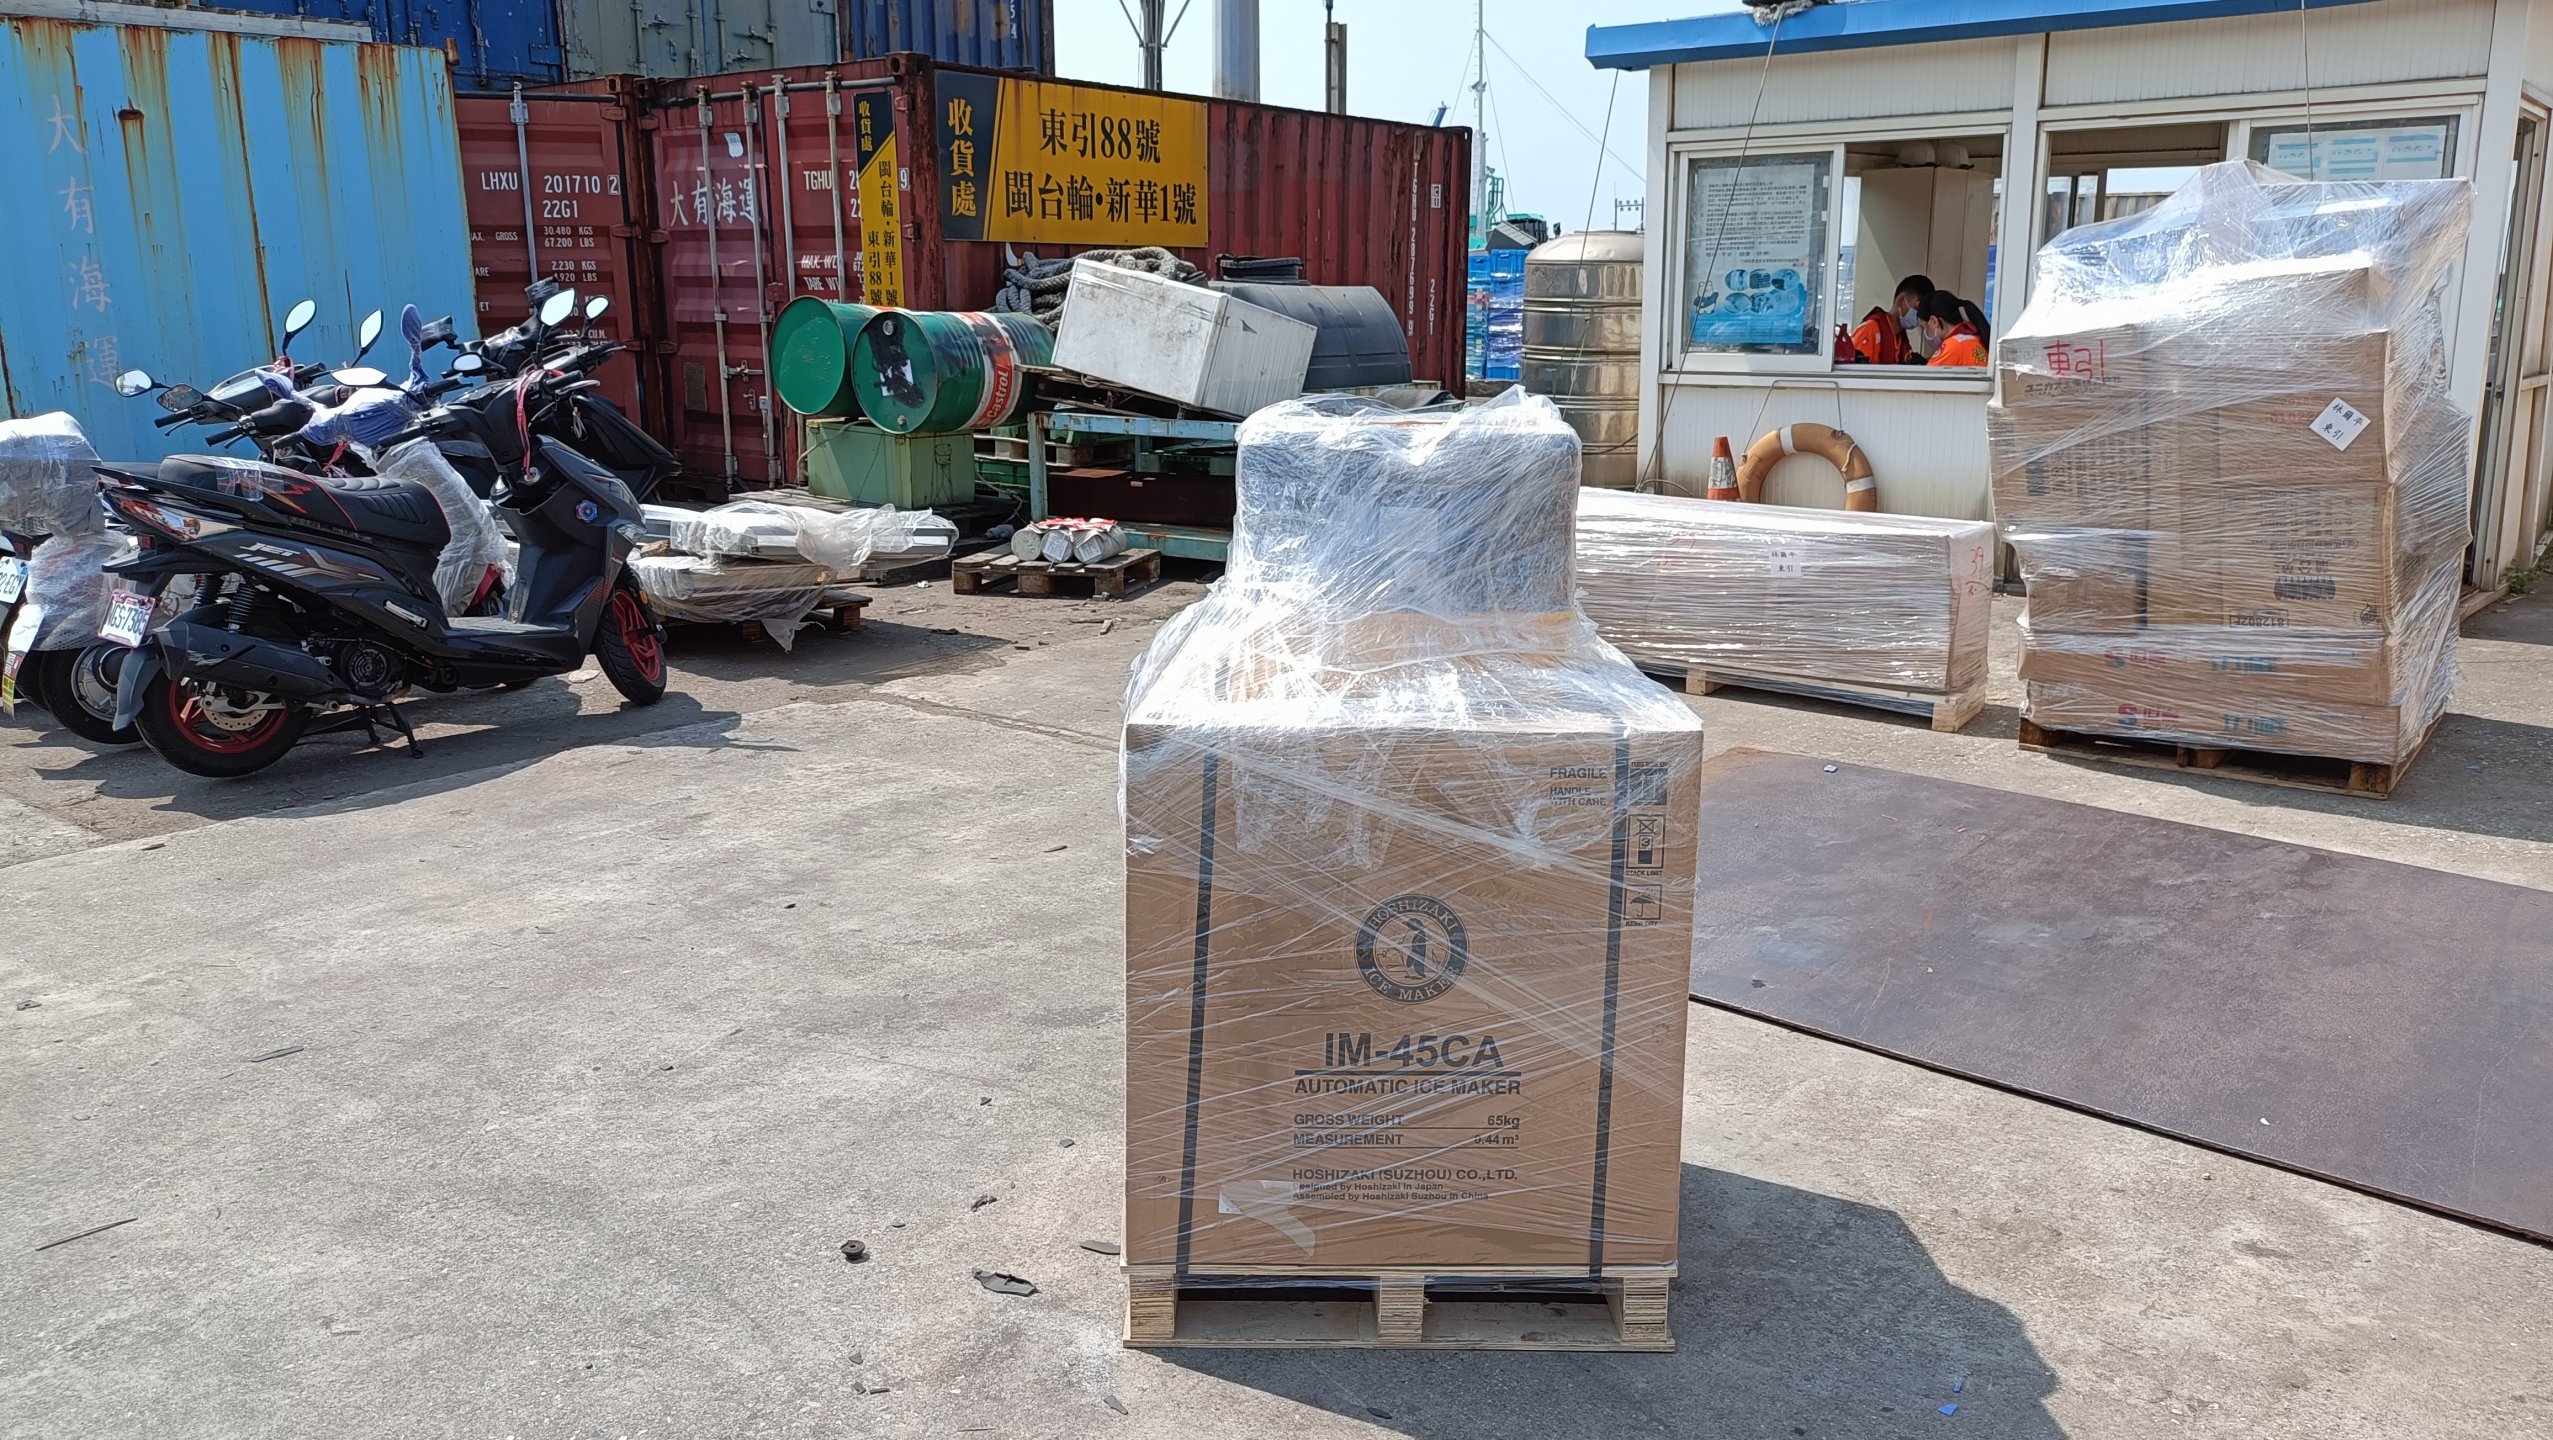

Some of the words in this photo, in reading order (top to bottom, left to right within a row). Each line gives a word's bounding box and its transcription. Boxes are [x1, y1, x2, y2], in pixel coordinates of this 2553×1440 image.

[859, 100, 873, 152] 收貨處
[1039, 108, 1161, 164] 東引88號
[948, 98, 977, 217] 收貨處
[481, 172, 518, 190] LHXU
[544, 175, 601, 194] 201710
[610, 175, 619, 194] 2
[803, 170, 832, 190] TGHU
[900, 169, 908, 188] 9
[542, 200, 579, 218] 22G1
[495, 232, 518, 241] GROSS
[543, 226, 572, 235] 30.480
[578, 227, 594, 235] KGS
[544, 238, 573, 247] 67.200
[579, 238, 595, 247] LBS
[475, 267, 490, 277] ARE
[551, 261, 575, 270] 2.230
[581, 261, 597, 270] KGS
[868, 230, 883, 305] 東引88號
[582, 273, 597, 281] LBS
[987, 370, 1009, 418] Castrol
[239, 542, 300, 557] JET
[1550, 767, 1607, 779] FRAGILE
[1550, 787, 1591, 796] HANDLE
[1578, 797, 1607, 806] CARE
[1641, 837, 1650, 847] 3
[1367, 900, 1458, 930] HOSHIZAKI
[1364, 967, 1393, 994] ICE
[1398, 965, 1460, 1000] MAKER
[1325, 1033, 1504, 1067] IM-45CA
[1294, 1079, 1408, 1094] AUTOMATIC
[1414, 1080, 1445, 1094] ICE
[1451, 1080, 1521, 1095] MAKER
[1294, 1114, 1344, 1125] GROSS
[1347, 1114, 1405, 1126] WEIGHT
[1487, 1115, 1520, 1129] 65kg
[1294, 1134, 1404, 1145] MEASUREMENT
[1292, 1169, 1375, 1180] HOSHIZAKI
[1379, 1169, 1452, 1181] (SUZHOU)
[1456, 1169, 1518, 1182] CO.,LTD.
[1340, 1183, 1352, 1191] by
[1415, 1183, 1443, 1191] Japan
[1293, 1192, 1345, 1200] Assembled
[1348, 1192, 1360, 1201] by
[1363, 1192, 1408, 1200] Hoshizaki
[1412, 1192, 1447, 1200] Suzhou
[1461, 1191, 1489, 1200] China
